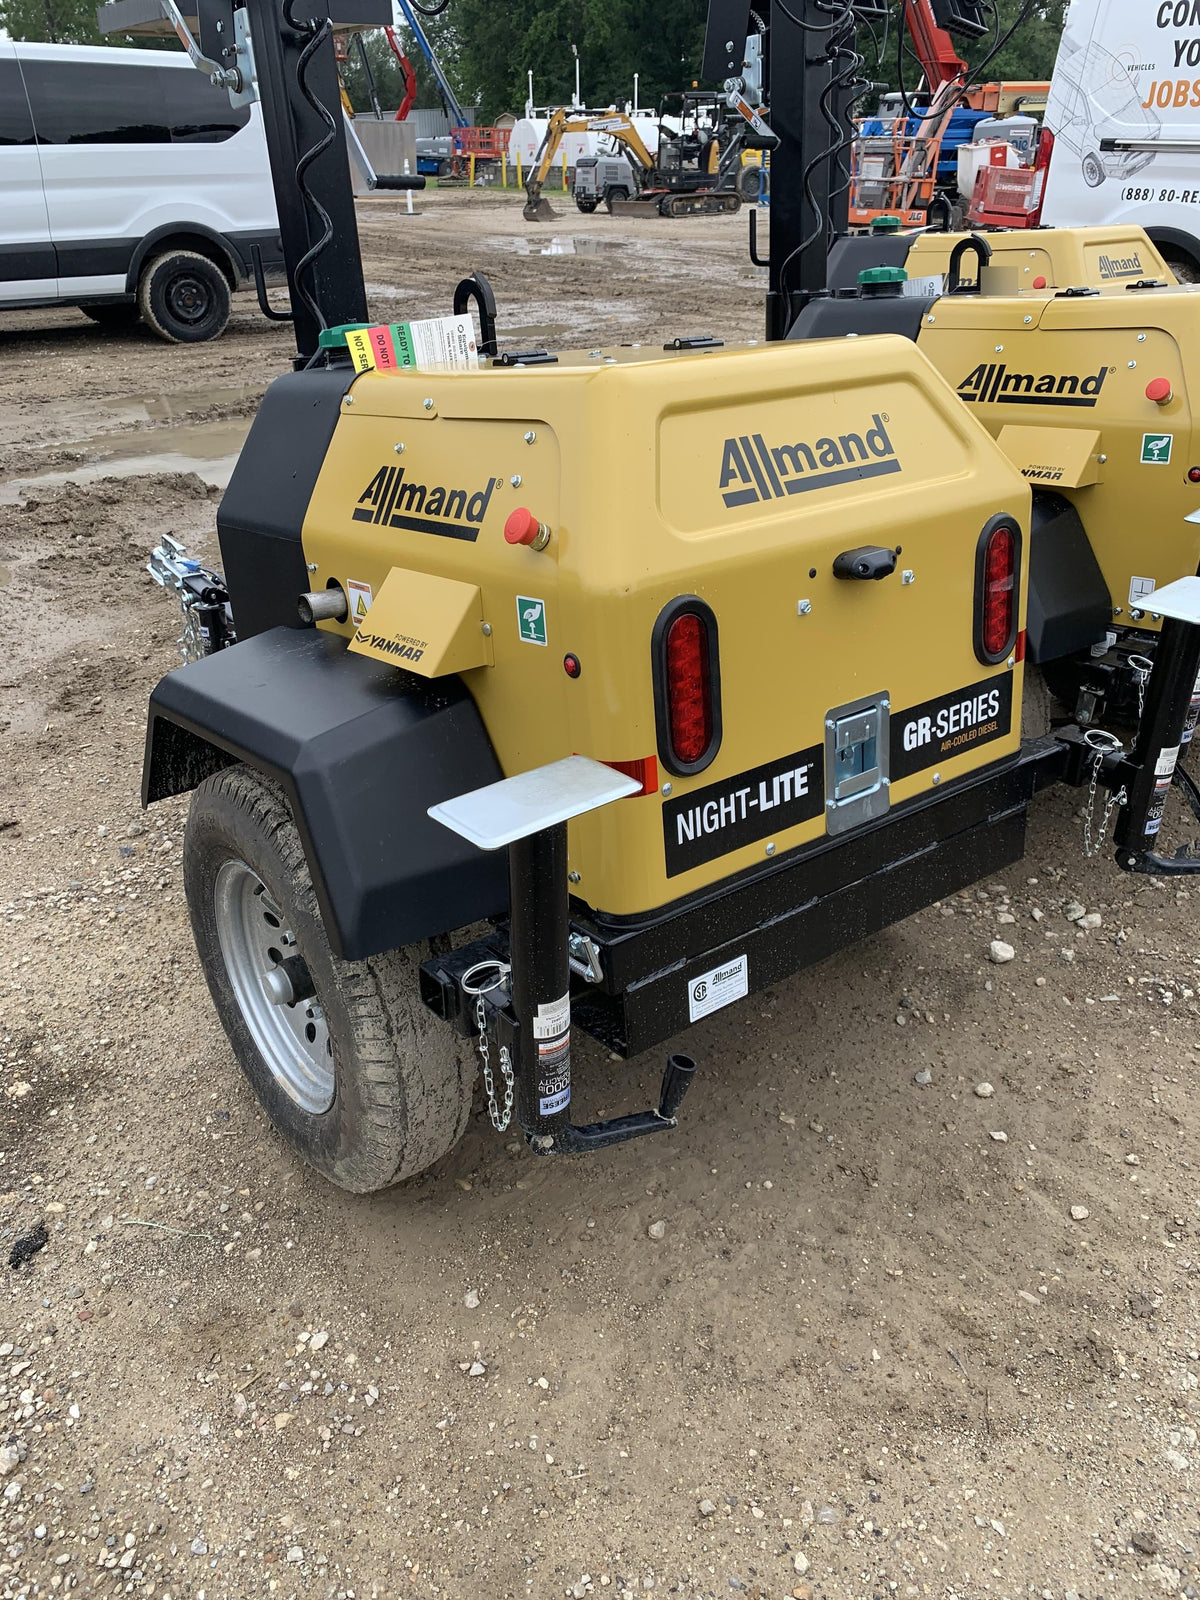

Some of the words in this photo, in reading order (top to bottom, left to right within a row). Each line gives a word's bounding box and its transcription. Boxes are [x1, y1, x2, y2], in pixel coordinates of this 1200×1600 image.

[1127, 63, 1156, 71] VEHICLES
[1121, 187, 1154, 202] (888)
[1158, 189, 1200, 203] 80-RE
[908, 212, 923, 221] JLG
[1099, 252, 1141, 278] Allmand
[353, 335, 365, 351] NOT
[376, 334, 385, 346] DO
[396, 326, 408, 353] READY
[380, 347, 389, 364] NOT
[401, 354, 411, 365] TO
[1021, 469, 1063, 480] NMAR
[394, 634, 420, 646] POWERED
[369, 635, 424, 662] YANMAR
[903, 689, 999, 751] GR-SERIES
[941, 729, 977, 752] AIR-COOLED
[978, 721, 998, 736] DIESEL
